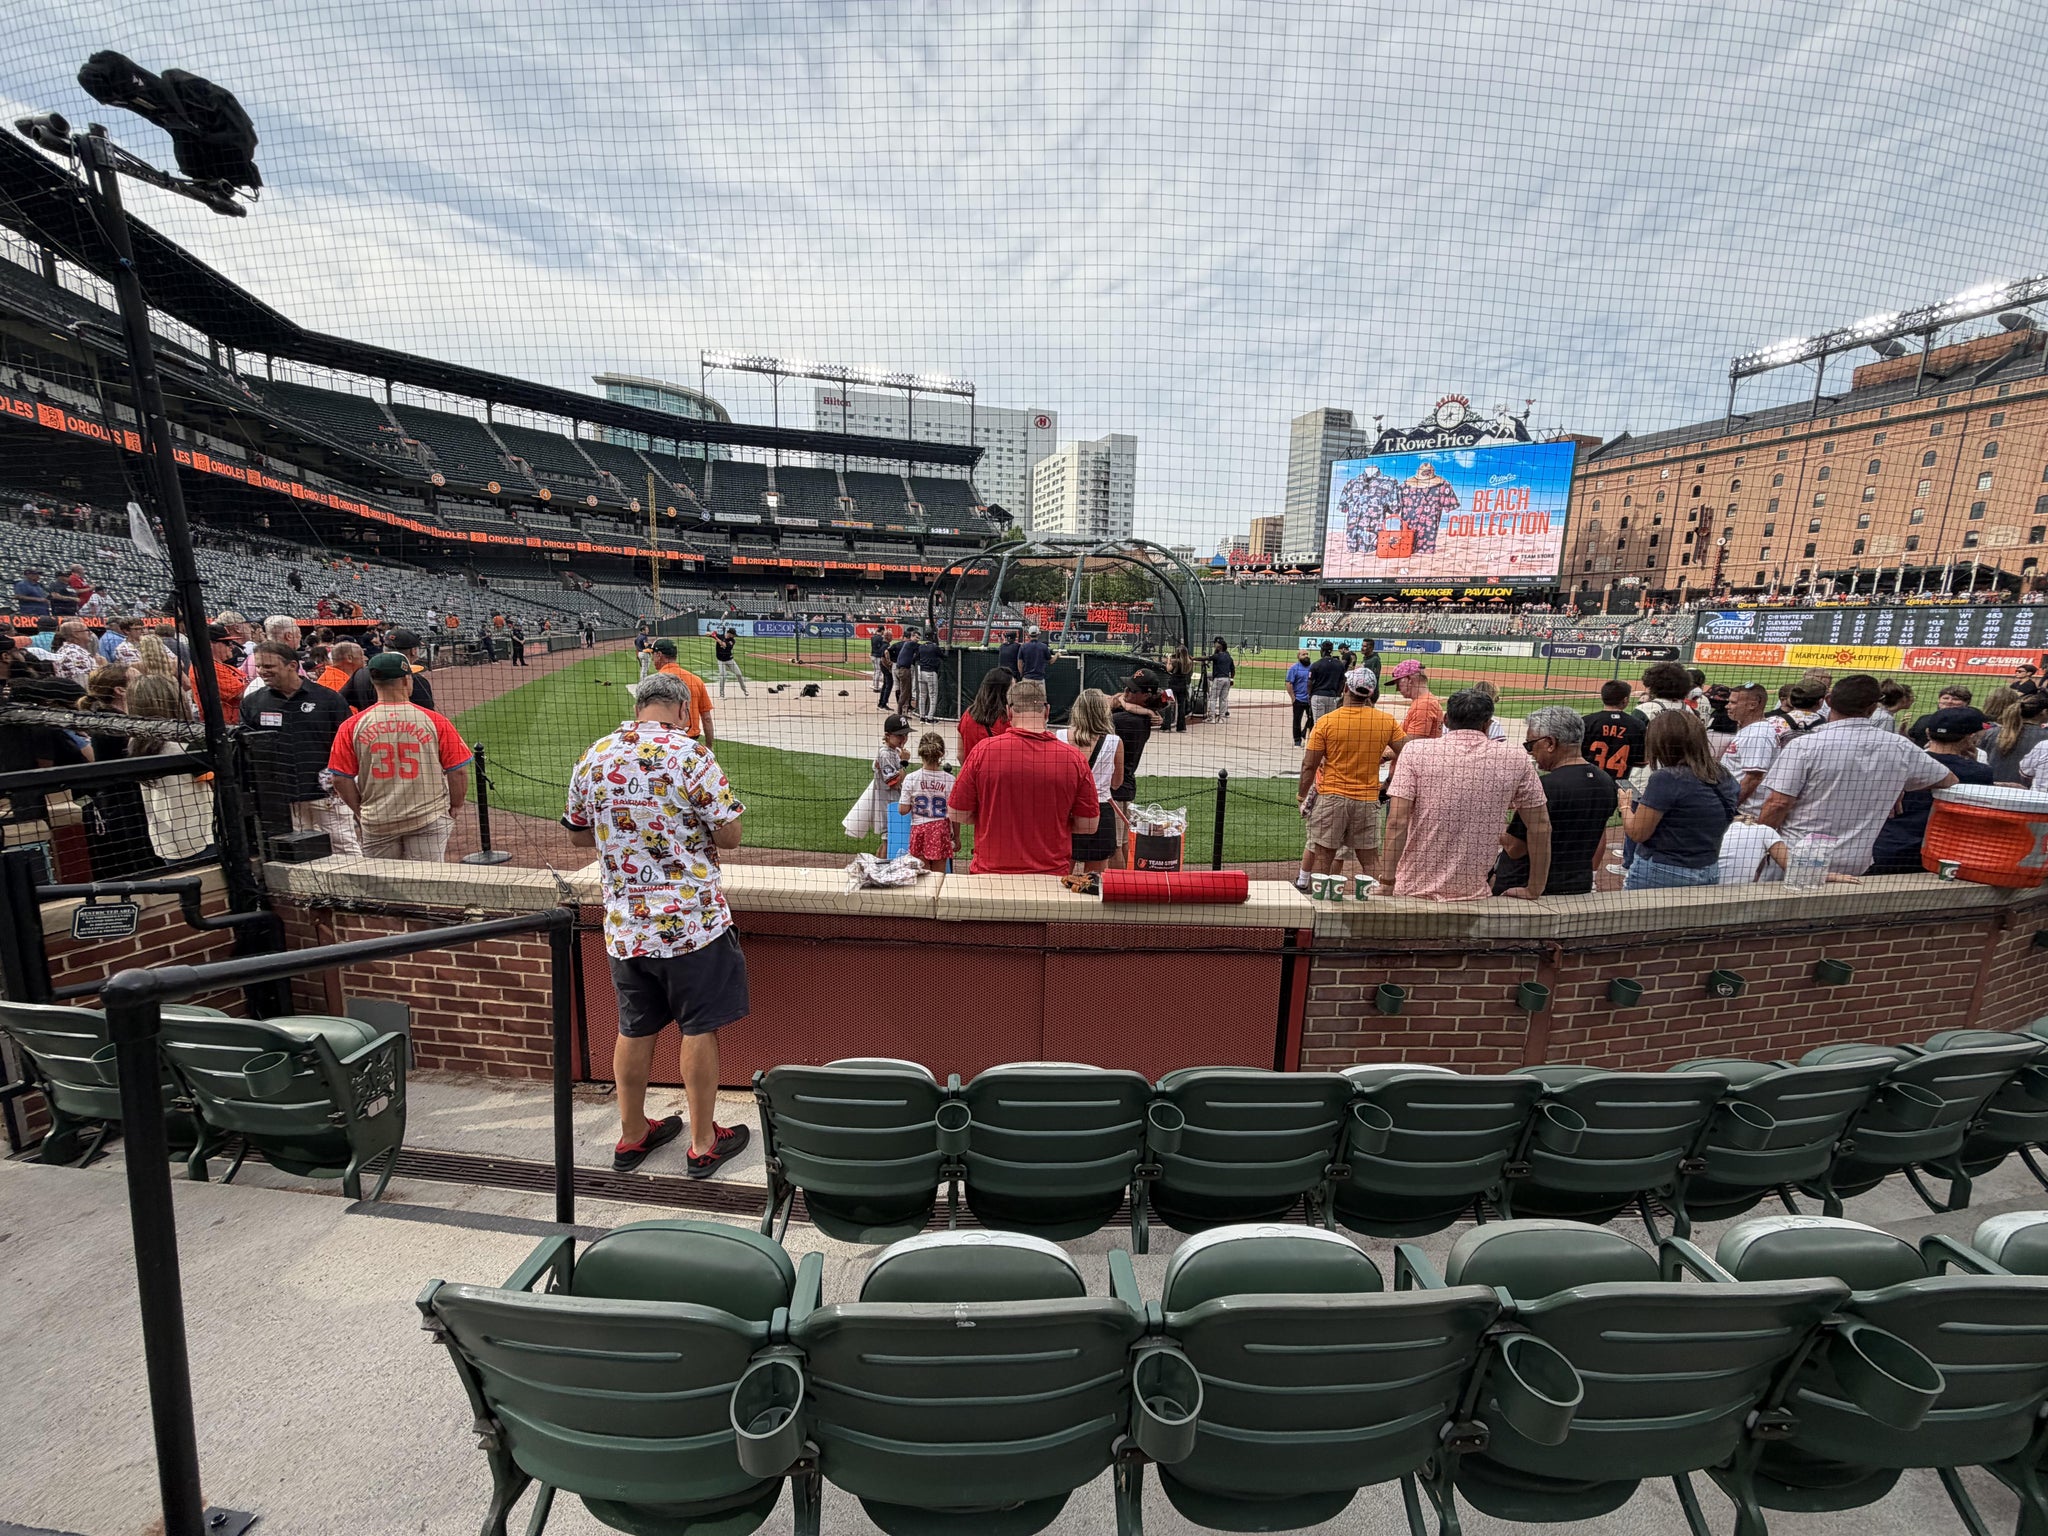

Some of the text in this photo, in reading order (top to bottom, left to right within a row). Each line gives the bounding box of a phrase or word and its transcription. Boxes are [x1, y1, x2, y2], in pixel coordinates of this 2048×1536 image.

[211, 460, 246, 480] ORIOLES
[262, 475, 291, 493] ORIOLES
[1473, 488, 1531, 513] BEACH
[1447, 511, 1551, 537] COLLECTION
[488, 535, 524, 545] ORIOLES
[543, 539, 576, 549] ORIOLES
[592, 545, 622, 554] ORIOLES
[748, 558, 778, 566] ORIOLES
[793, 560, 823, 568] ORIOLES
[838, 562, 867, 570] ORIOLES
[881, 564, 908, 572] ORIOLES
[1400, 588, 1513, 596] PUREWAGER PAVILION
[1712, 627, 1757, 635] CENTRAL
[1912, 656, 1957, 670] HIGH'S
[1988, 656, 2035, 664] CARROLL
[357, 720, 433, 746] RUTSCHMAN
[1602, 725, 1627, 739] BAZ
[370, 742, 420, 779] 35
[1589, 741, 1630, 778] 34
[920, 780, 946, 793] OLSON
[613, 799, 659, 808] BALTIMORE
[915, 795, 947, 818] 28
[628, 884, 676, 894] BALTIMORE
